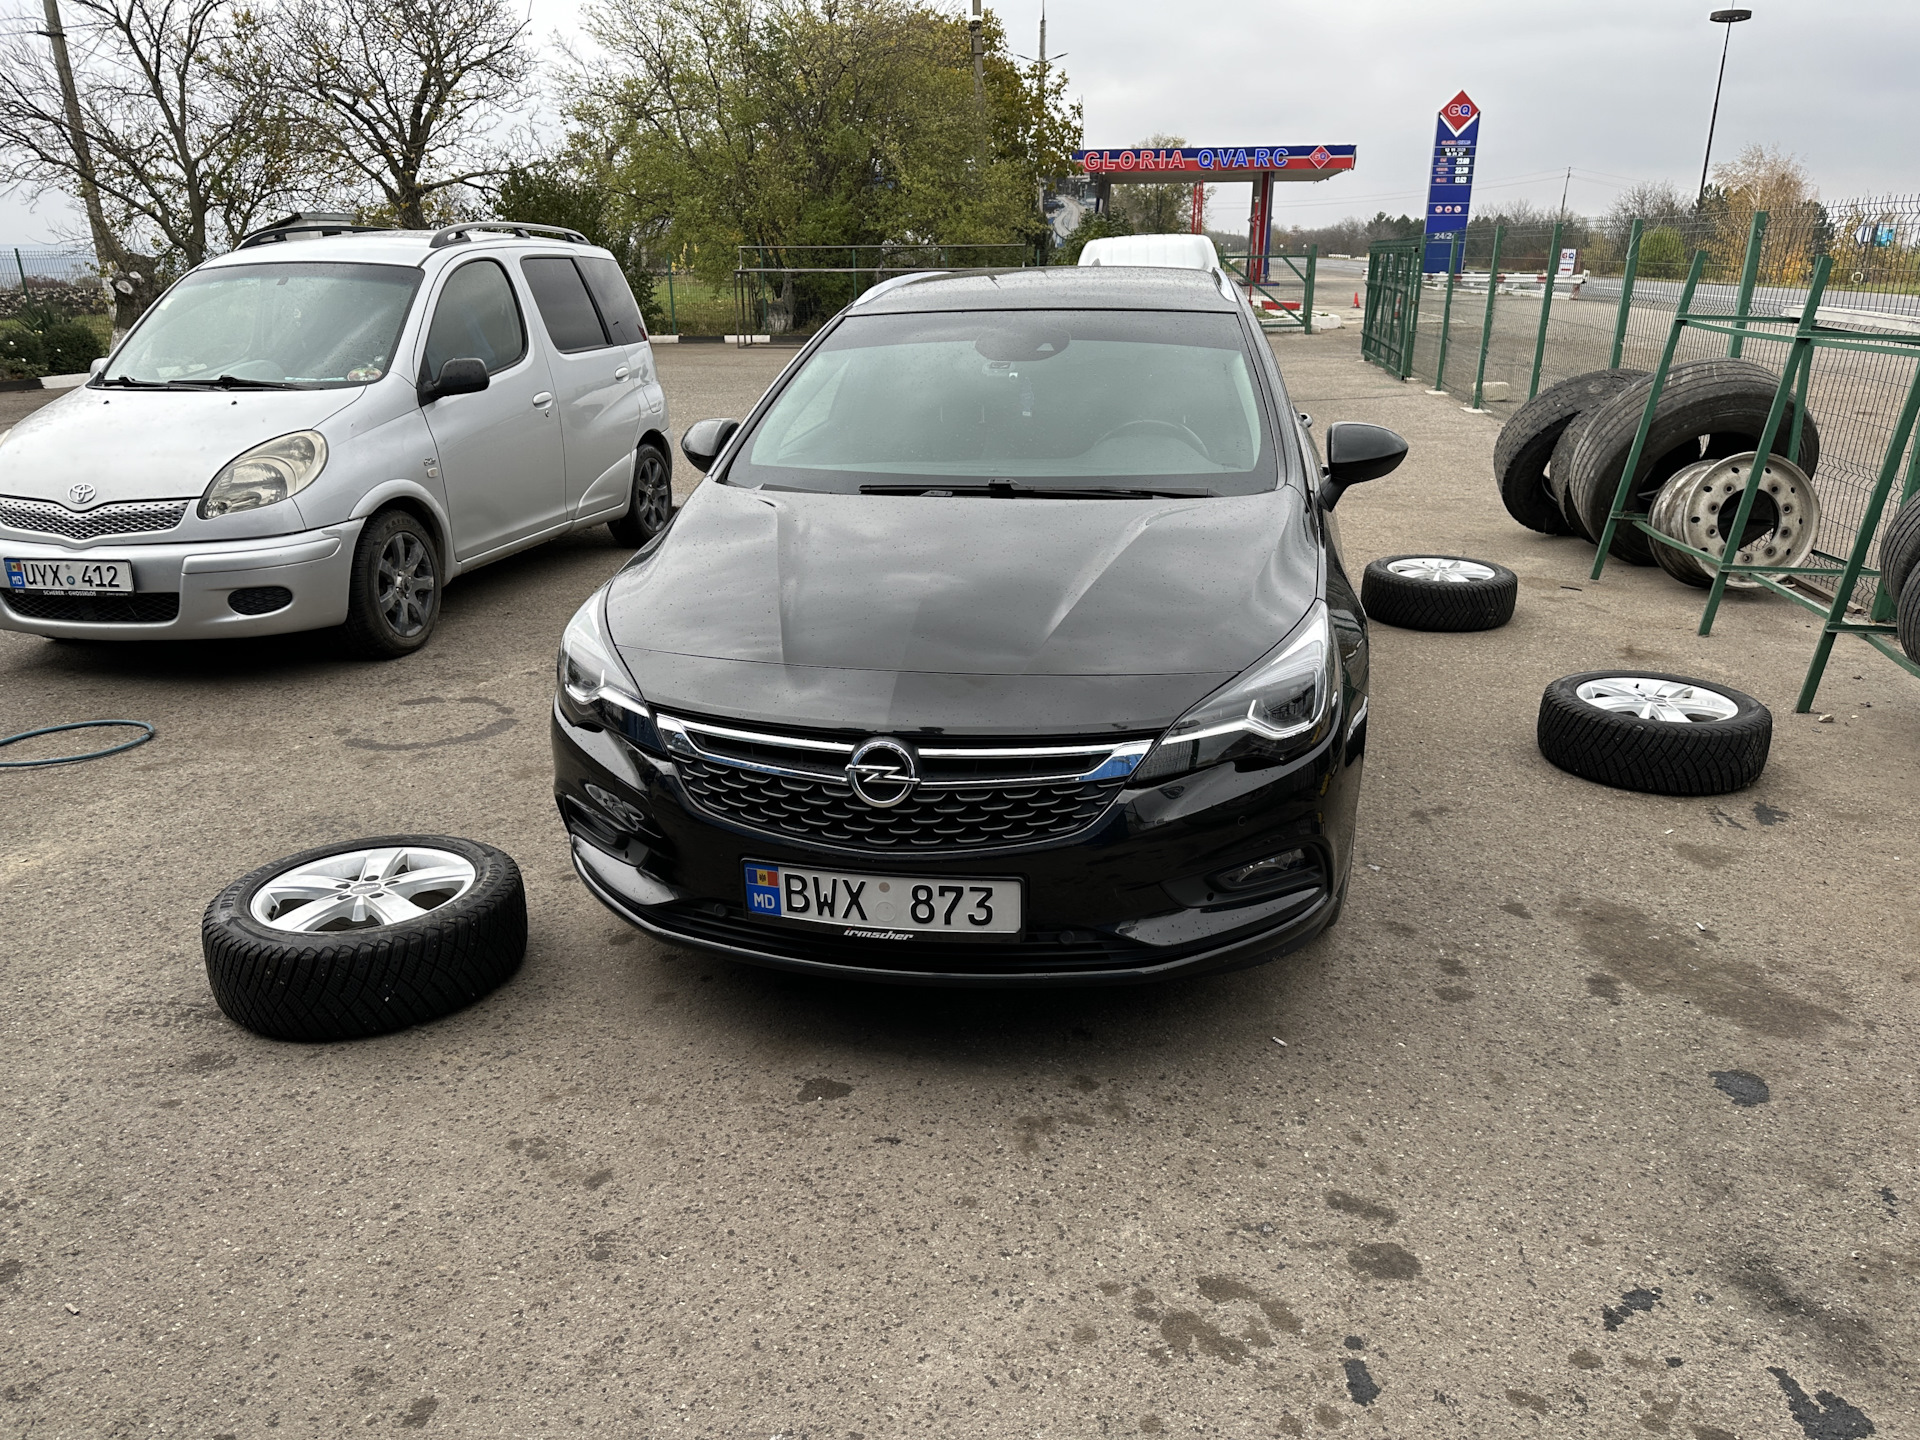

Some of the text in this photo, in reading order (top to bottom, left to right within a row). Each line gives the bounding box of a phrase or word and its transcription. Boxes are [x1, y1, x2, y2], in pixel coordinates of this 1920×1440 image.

[1448, 104, 1471, 117] GQ
[1084, 148, 1288, 170] GLORIA QVARC
[1312, 152, 1327, 160] GQ
[1434, 232, 1455, 240] 24/2
[1562, 252, 1574, 260] GQ
[11, 563, 120, 588] MD UYX 412
[753, 873, 994, 926] MD BWX 873
[844, 927, 914, 941] irmscher
